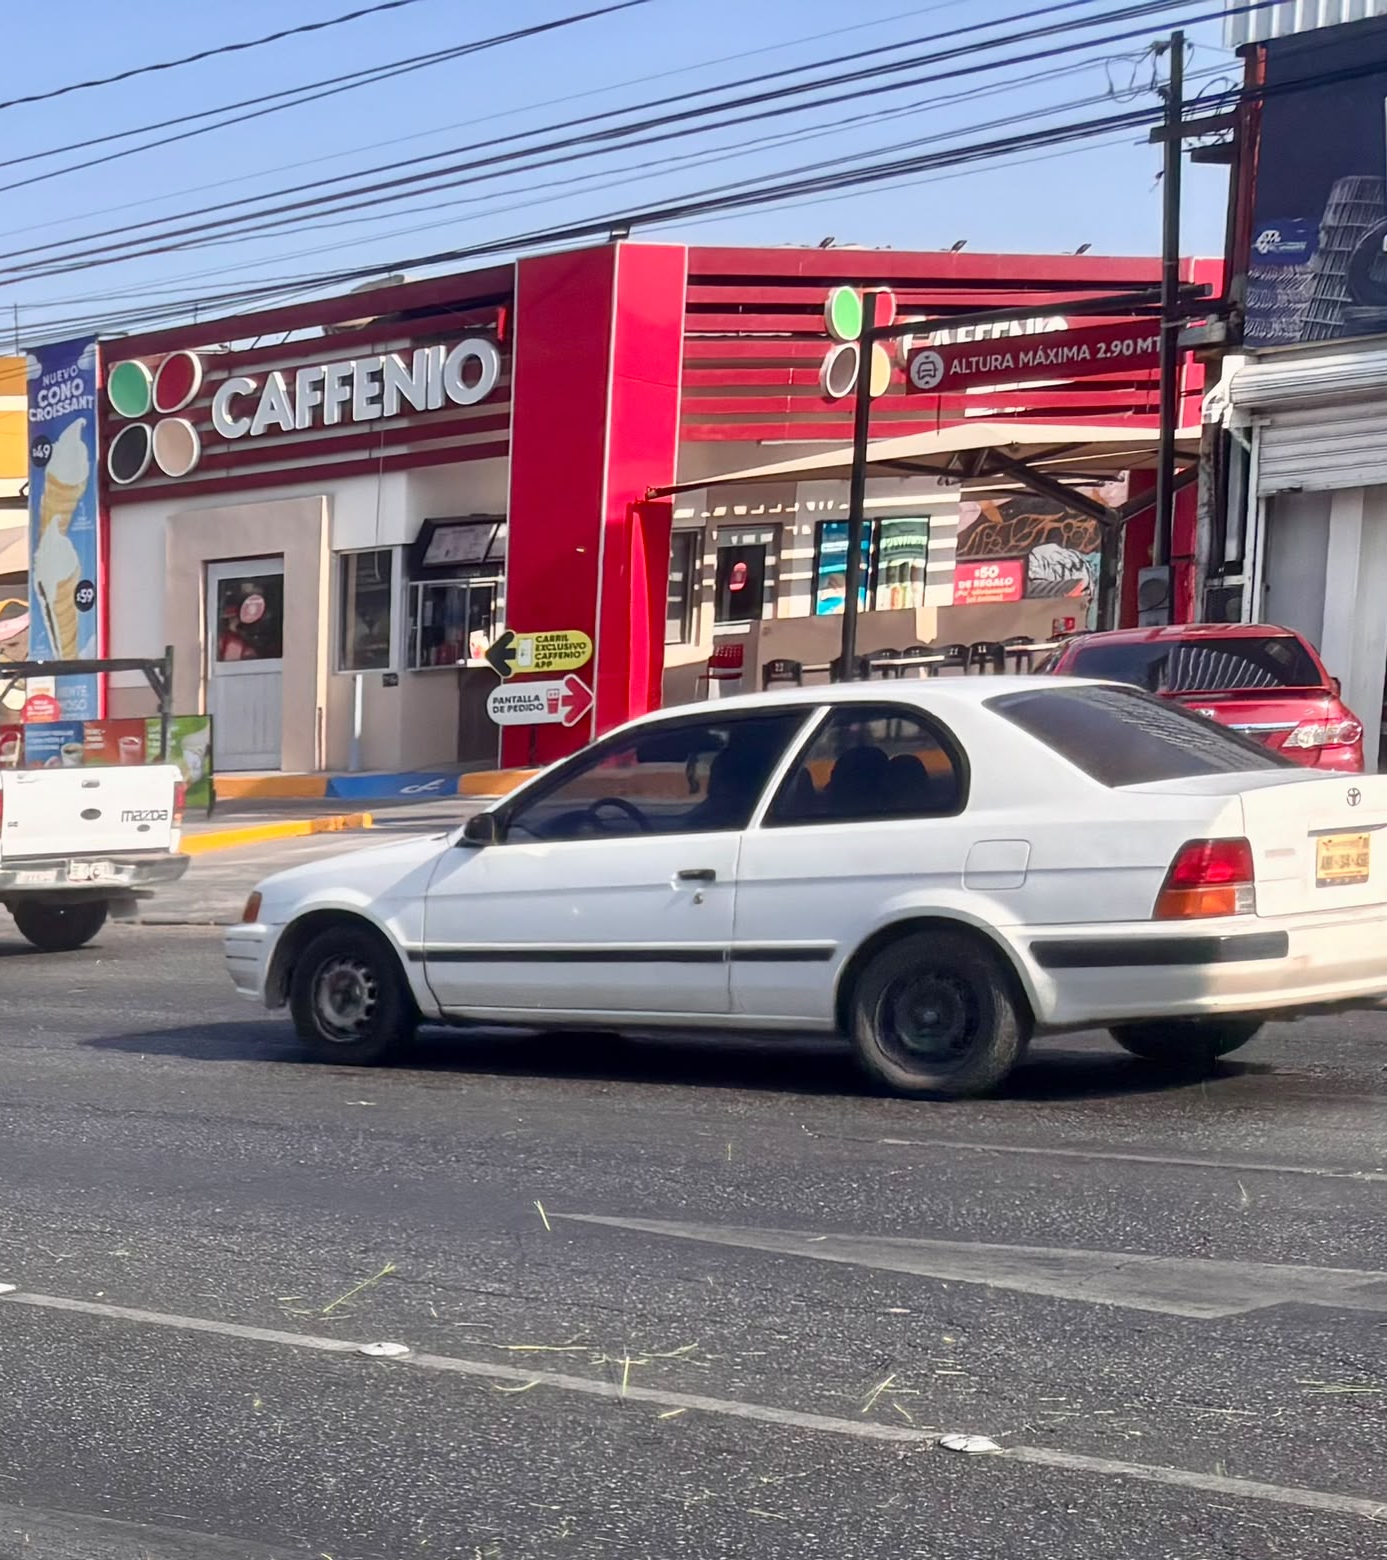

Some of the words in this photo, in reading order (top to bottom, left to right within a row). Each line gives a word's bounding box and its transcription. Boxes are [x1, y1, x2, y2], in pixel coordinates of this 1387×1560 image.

[949, 356, 1015, 376] ALTURA
[1019, 345, 1090, 370] MÁXIMA
[1095, 339, 1133, 359] 2.90
[42, 365, 78, 386] NUEVO
[38, 378, 84, 407] CONO
[212, 338, 501, 439] CAFFENIO
[29, 395, 94, 421] CROISSANT
[535, 635, 568, 643] CARRIL
[535, 642, 586, 652] EXCLUSIVO
[493, 695, 540, 704] PANTALLA
[493, 706, 505, 714] DE
[507, 703, 544, 713] PEDIDO
